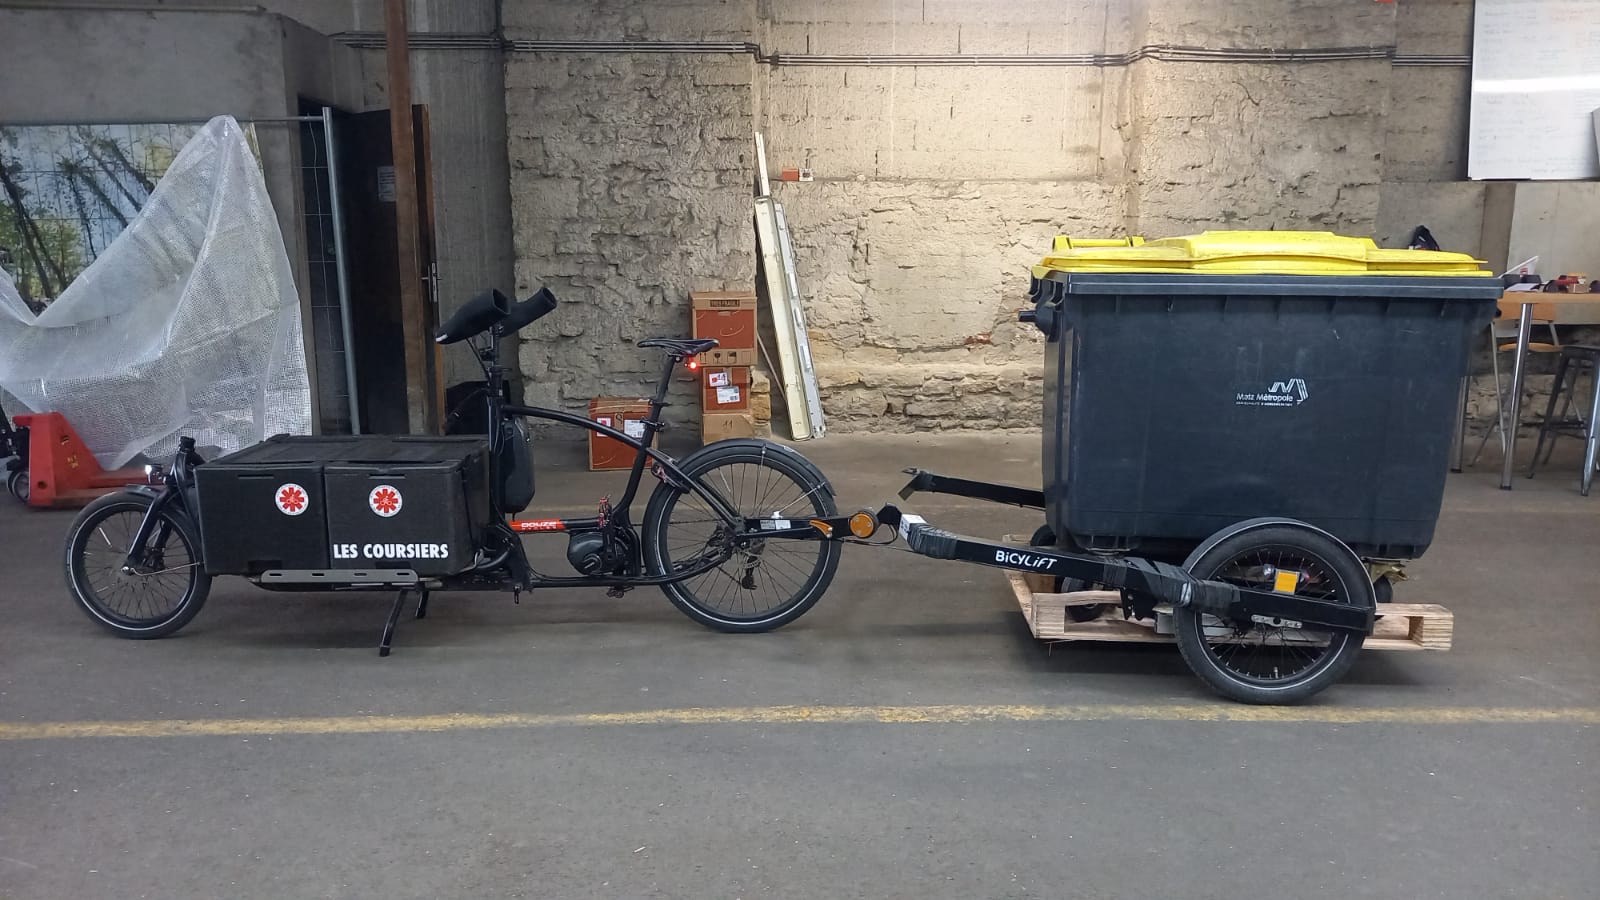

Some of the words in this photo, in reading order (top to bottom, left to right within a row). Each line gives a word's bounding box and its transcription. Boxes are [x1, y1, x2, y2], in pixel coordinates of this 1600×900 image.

[1256, 393, 1293, 402] Métropole
[333, 543, 359, 559] LES
[363, 543, 449, 559] COURSIERS
